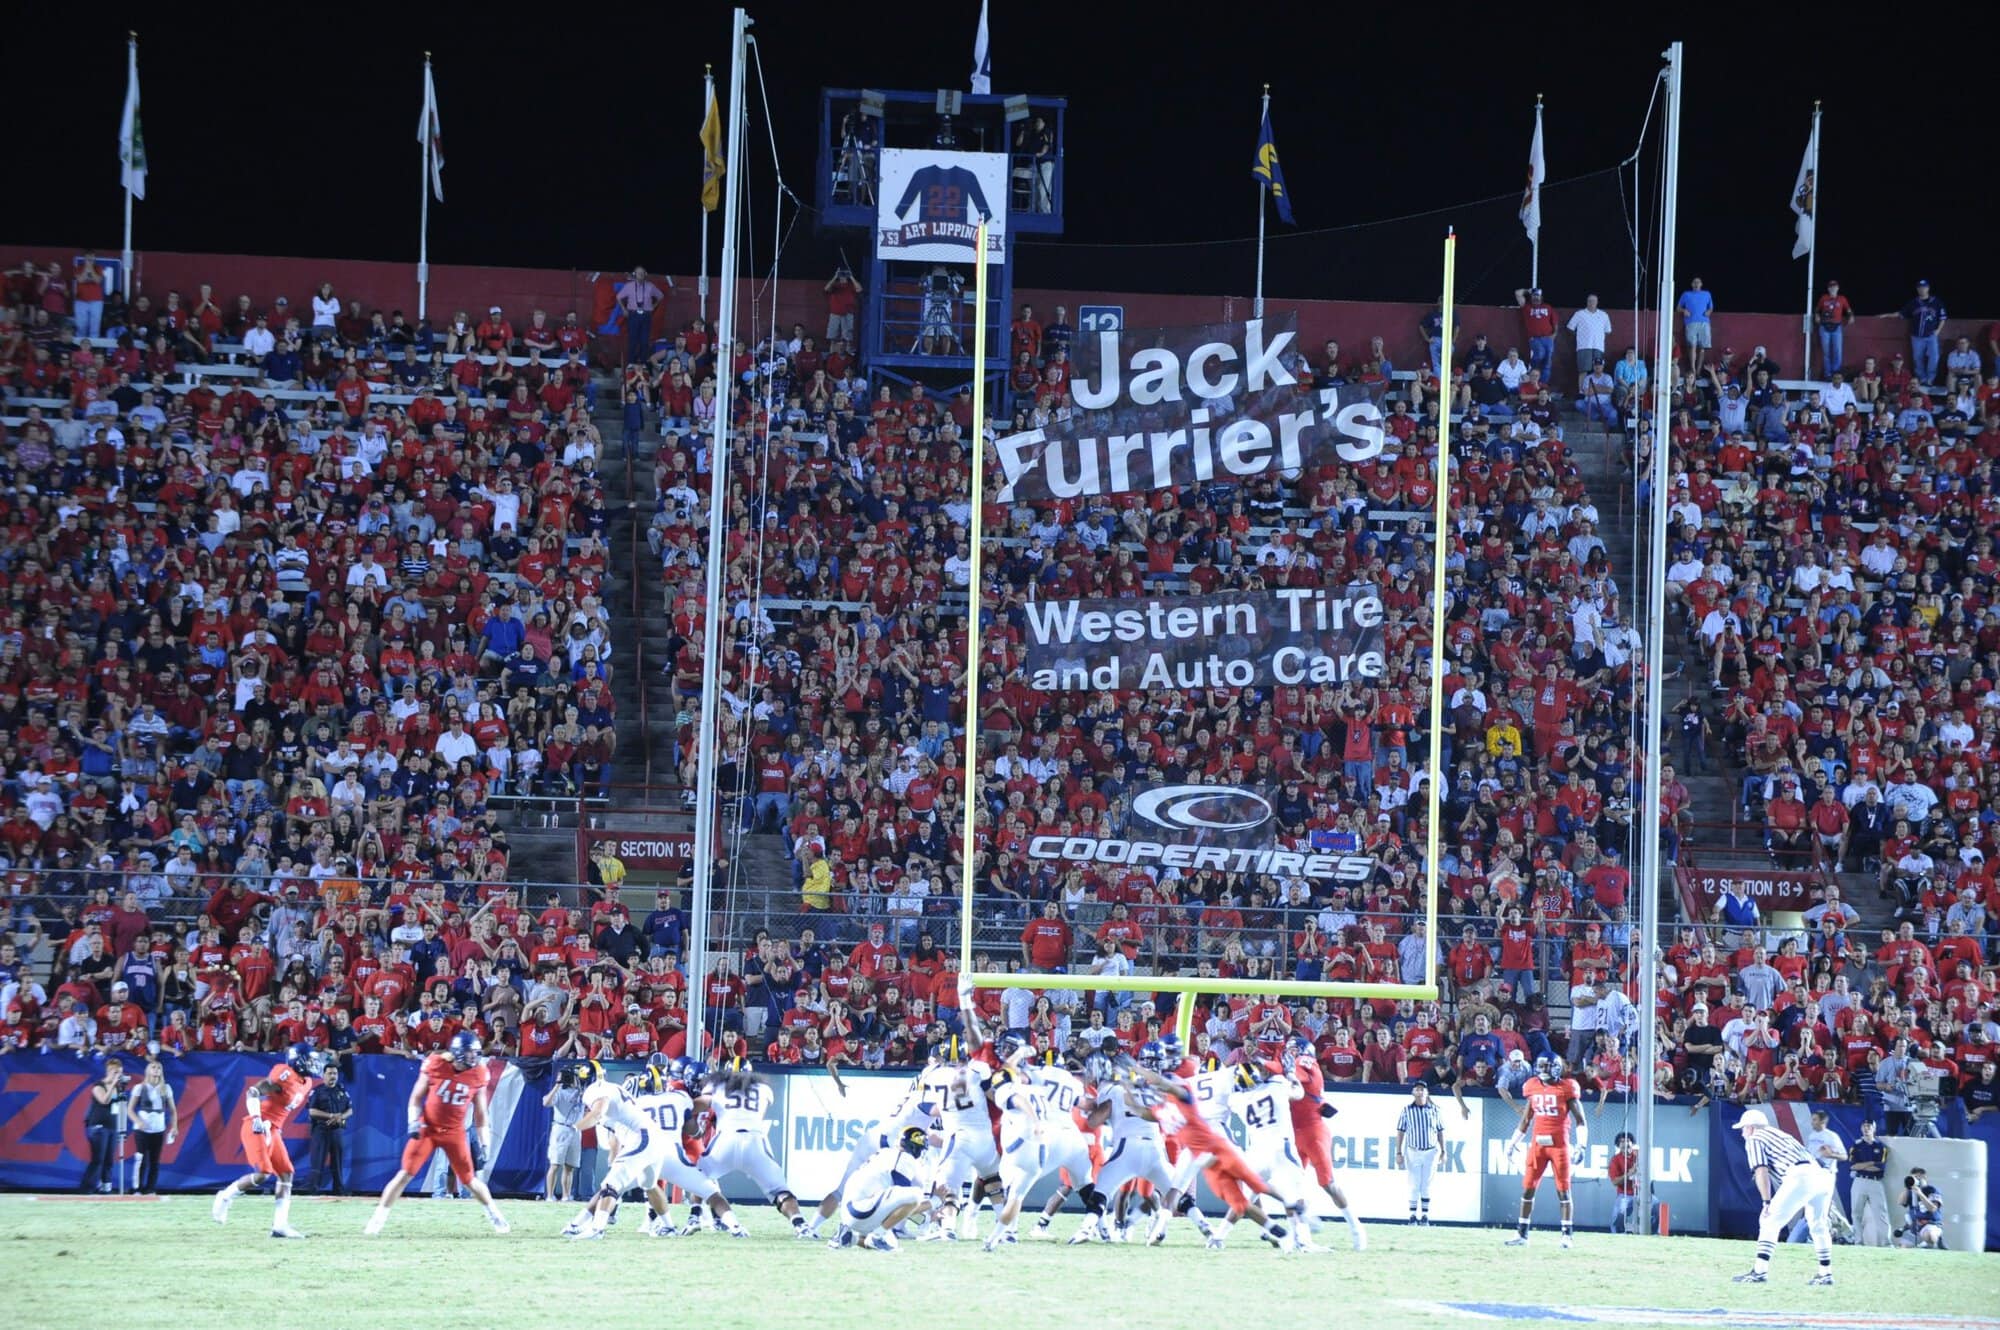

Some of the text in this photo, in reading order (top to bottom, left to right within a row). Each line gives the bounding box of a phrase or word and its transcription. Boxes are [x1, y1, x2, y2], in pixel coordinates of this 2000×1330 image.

[904, 221, 928, 240] ART
[1071, 318, 1298, 410] Jack
[994, 388, 1385, 503] Furrier's
[1024, 588, 1384, 646] Western Tire
[1031, 646, 1384, 691] and Auto Care
[1867, 813, 1877, 829] 7
[620, 841, 673, 858] SECTION
[1028, 835, 1375, 881] COOPERTIRES
[1701, 878, 1790, 897] 12 SETION 13
[1543, 894, 1561, 911] 32
[873, 953, 881, 971] 7
[1597, 1007, 1608, 1025] 21
[436, 1079, 470, 1106] 42
[724, 1086, 760, 1112] 58
[1044, 1080, 1073, 1113] 70
[1246, 1095, 1277, 1128] 47
